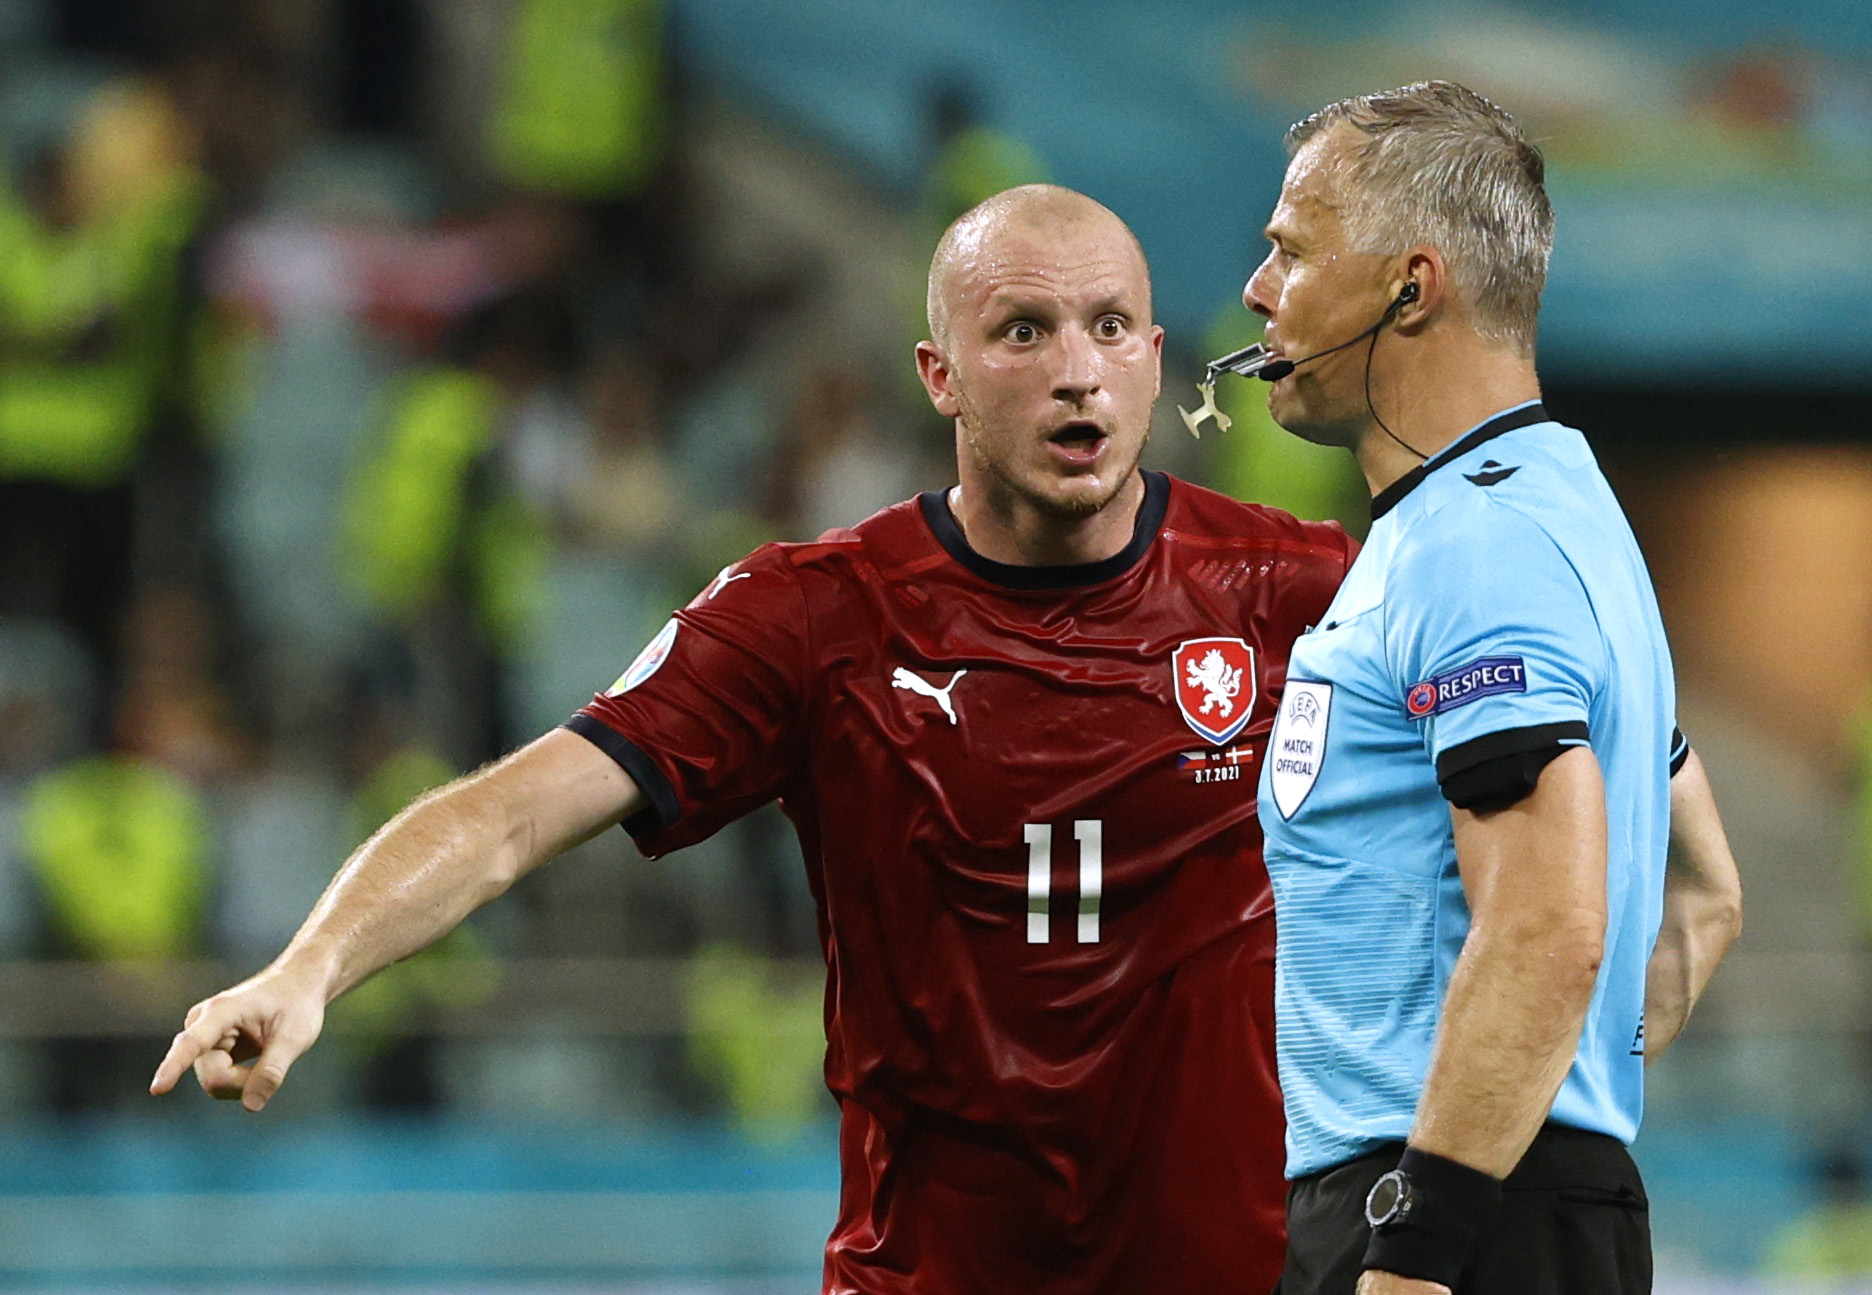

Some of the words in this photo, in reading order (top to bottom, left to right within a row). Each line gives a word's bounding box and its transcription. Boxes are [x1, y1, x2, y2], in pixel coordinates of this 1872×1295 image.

[1439, 665, 1522, 701] RESPECT
[1289, 697, 1317, 721] UEFA
[1283, 739, 1313, 756] MATCH
[1195, 765, 1240, 784] 3.7.2021
[1276, 758, 1312, 776] OFFICIAL
[1023, 819, 1102, 944] 11
